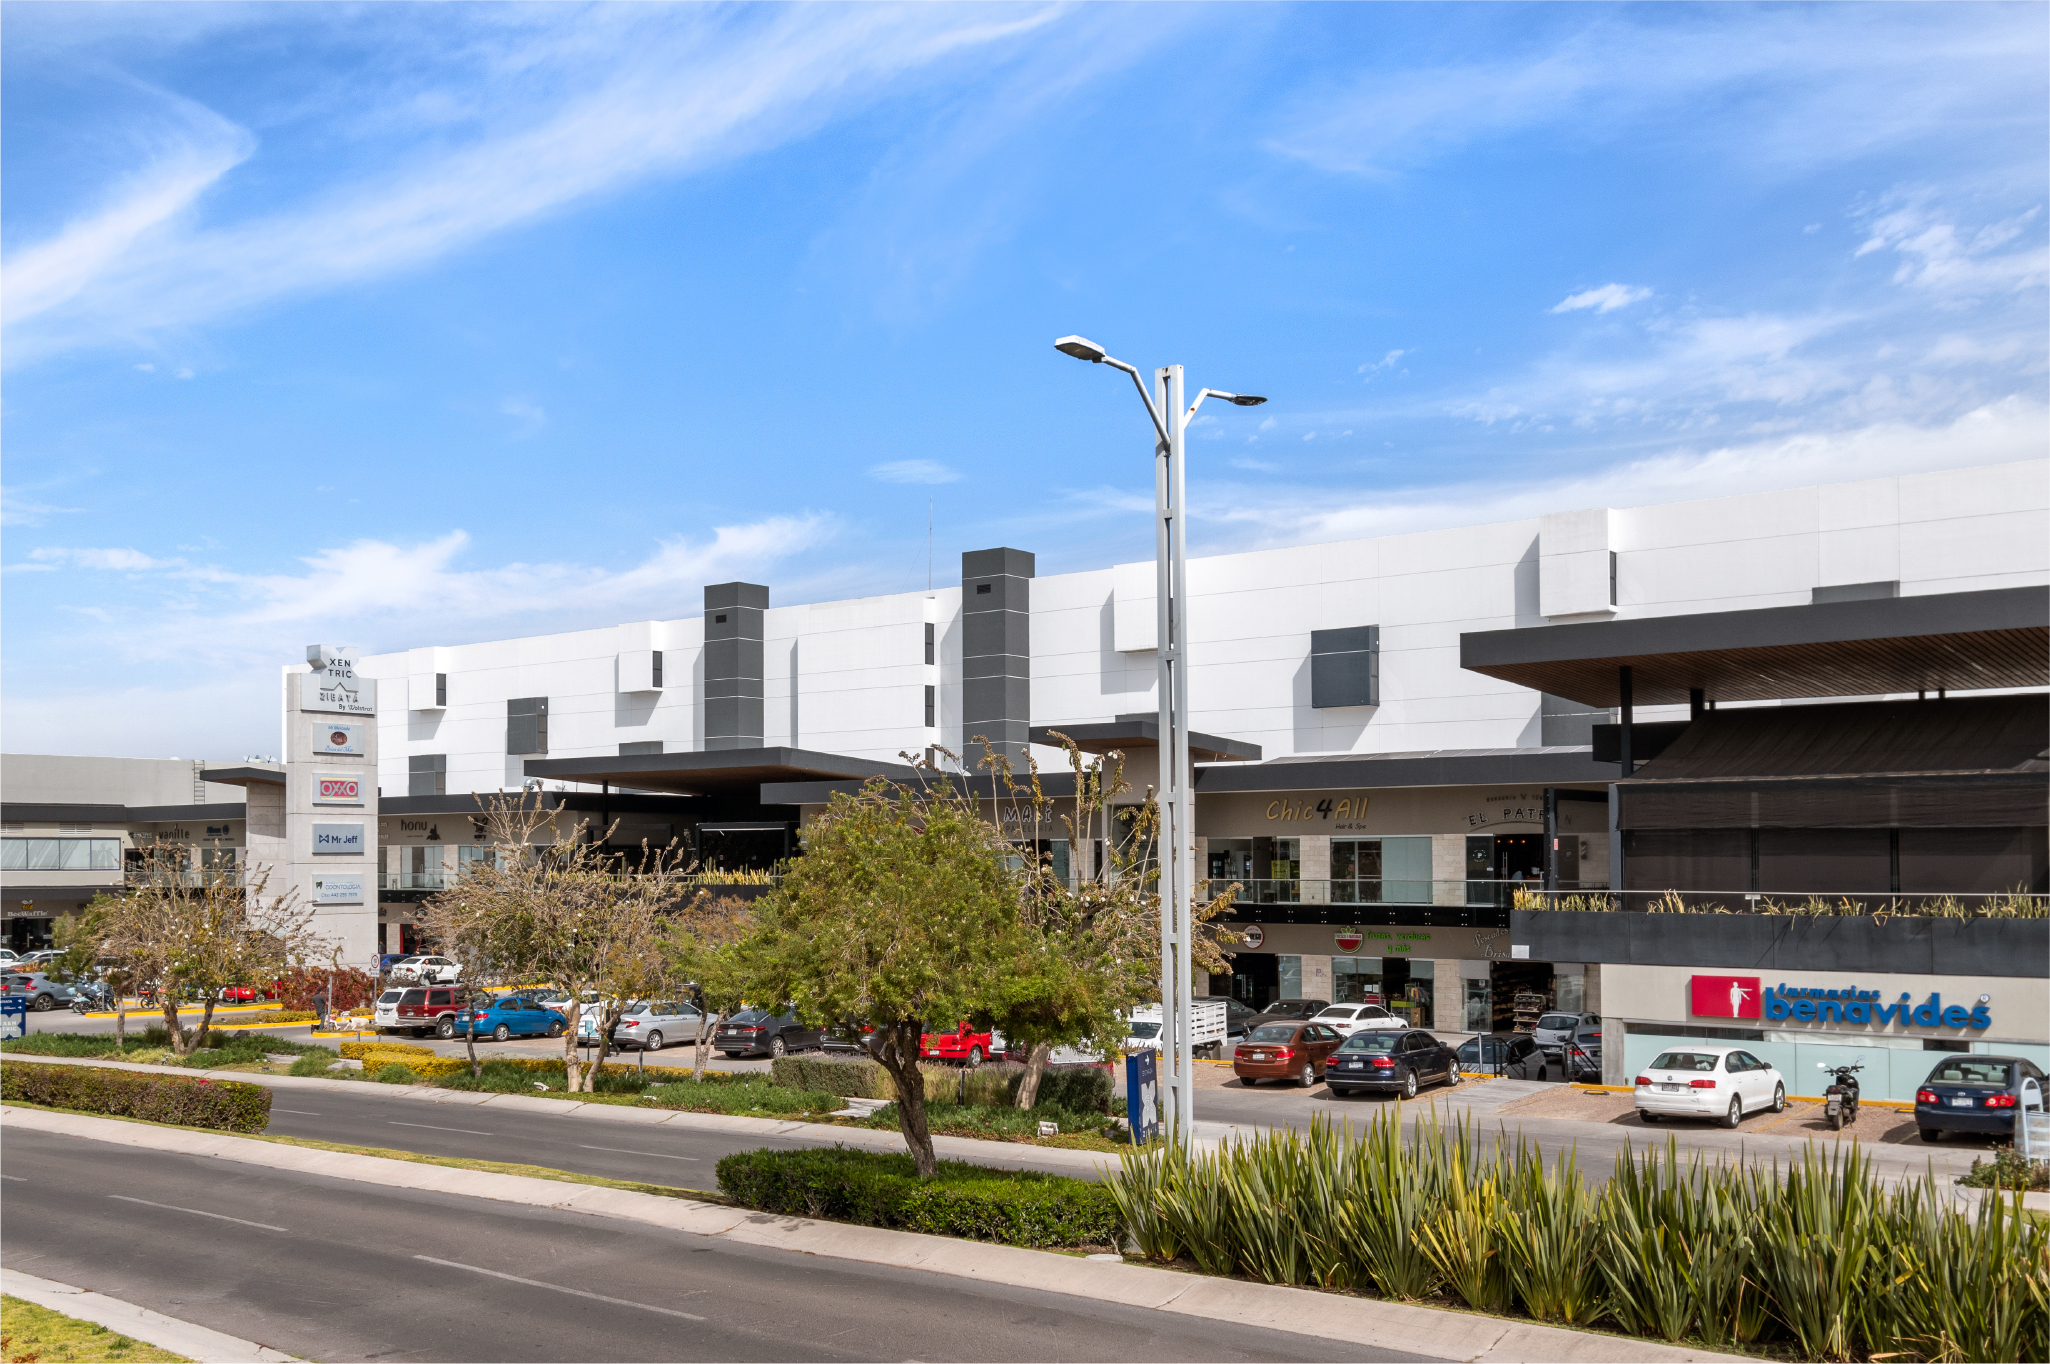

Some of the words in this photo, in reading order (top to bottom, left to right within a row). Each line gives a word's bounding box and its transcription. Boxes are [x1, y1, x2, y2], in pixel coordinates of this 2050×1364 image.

[329, 658, 351, 668] XEN
[328, 669, 352, 678] TRIC
[321, 780, 358, 797] OXXO
[400, 819, 428, 831] honu
[1468, 812, 1488, 826] EL
[331, 835, 342, 844] Mr
[343, 835, 358, 844] Jeff
[1387, 944, 1392, 954] y
[1394, 944, 1410, 952] más
[1778, 983, 1881, 999] farmacias
[1765, 986, 1992, 1029] benavides
